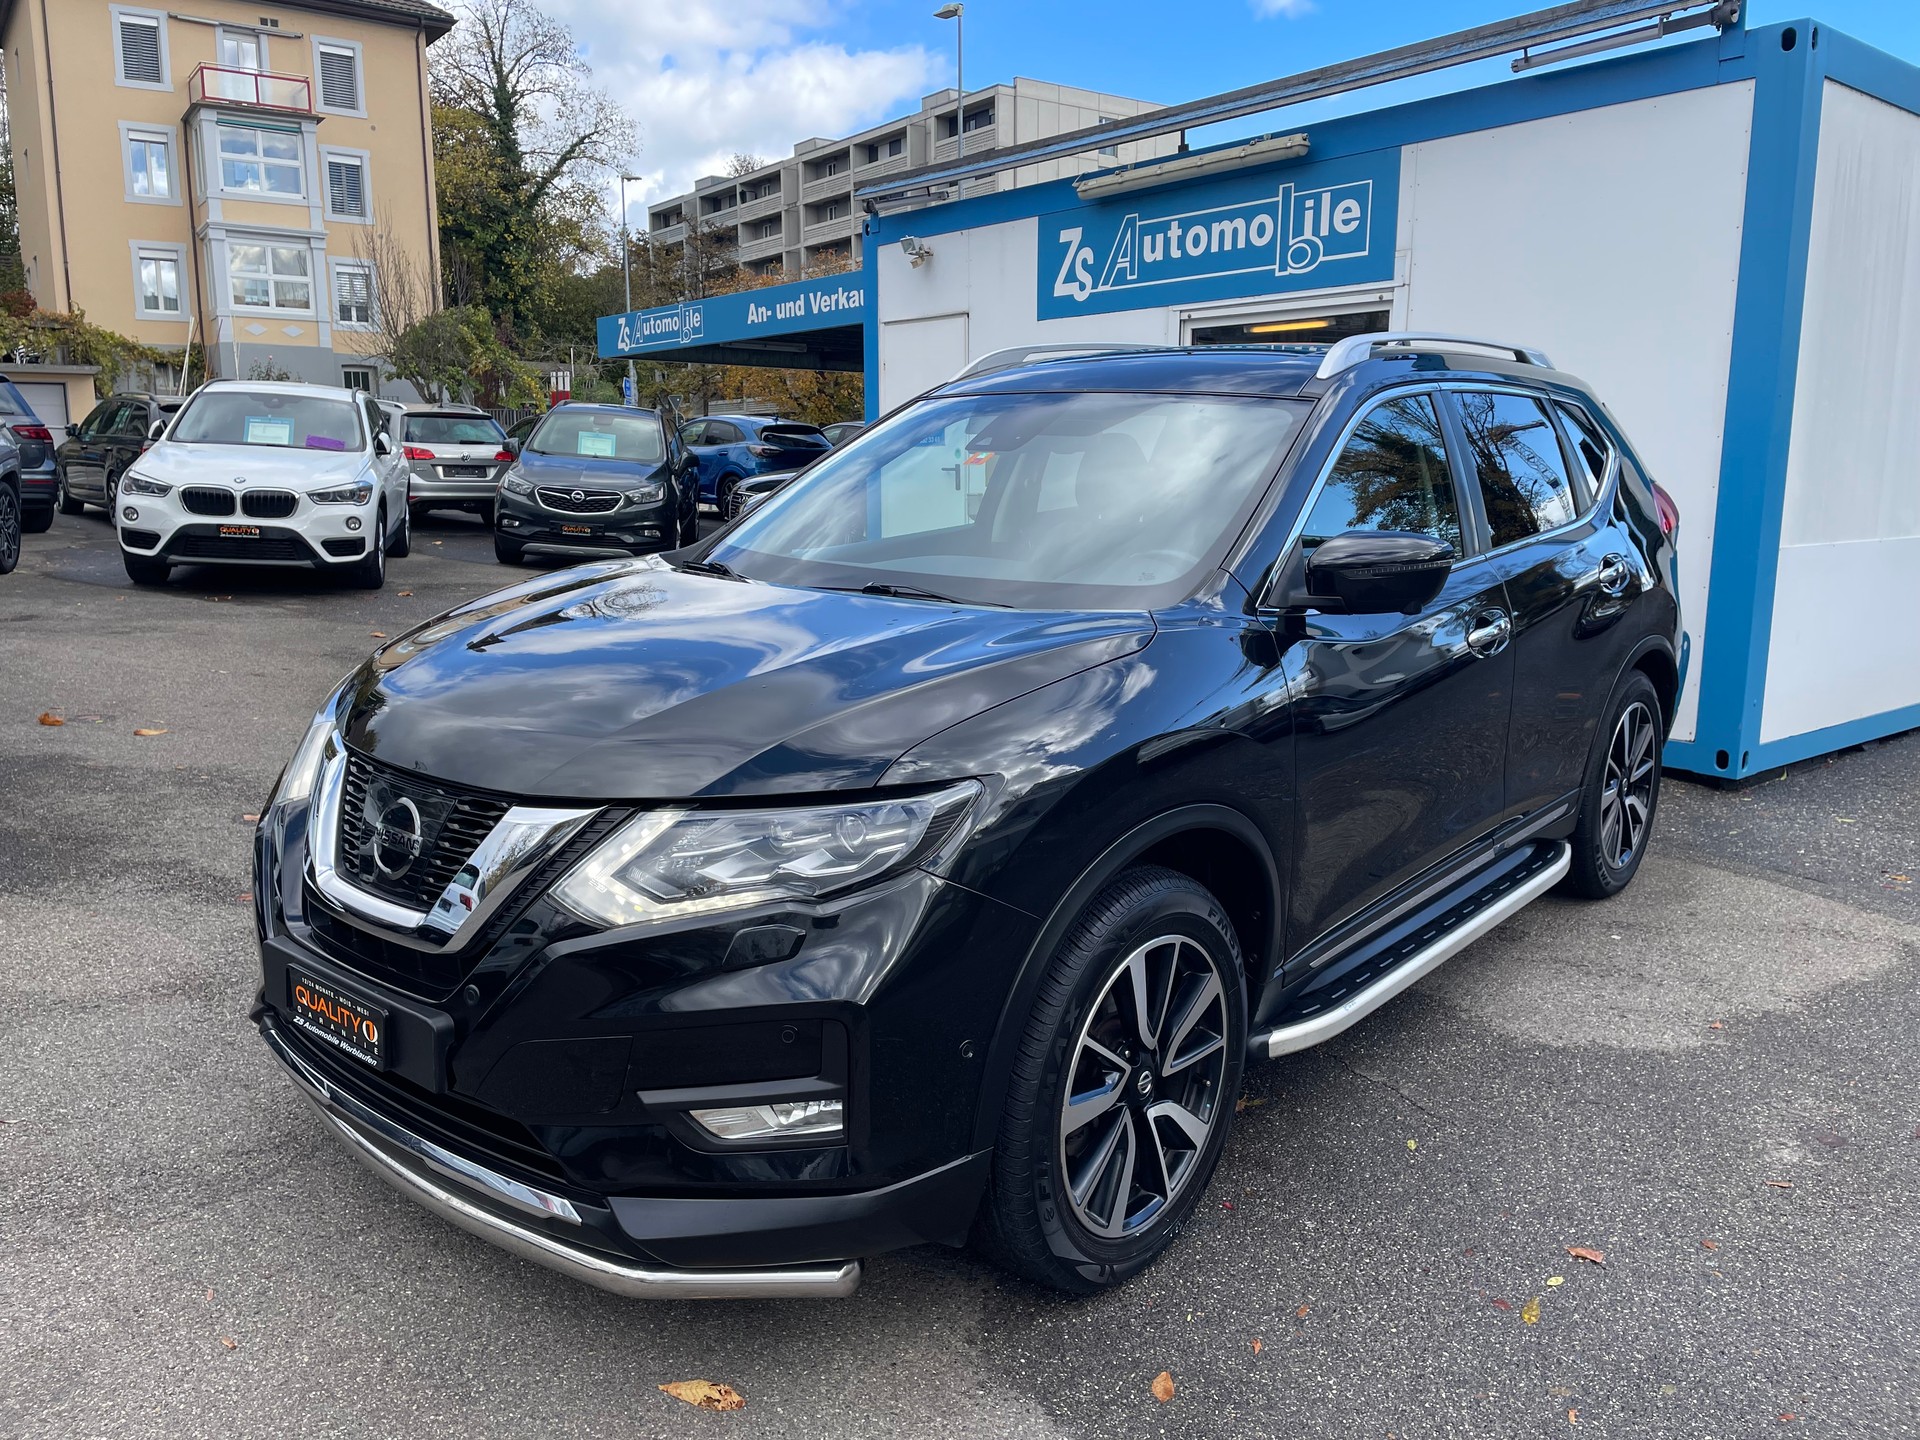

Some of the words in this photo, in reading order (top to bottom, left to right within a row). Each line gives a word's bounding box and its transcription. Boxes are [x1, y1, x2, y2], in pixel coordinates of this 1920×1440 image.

[1099, 182, 1362, 287] Automobile
[631, 304, 701, 347] Automobile
[747, 303, 772, 325] An-
[776, 294, 805, 319] und
[295, 985, 361, 1033] QUALITY
[315, 984, 334, 999] MONATE
[297, 1005, 379, 1055] GARANTIE
[303, 1021, 340, 1046] Automobile
[340, 1040, 378, 1067] Worblaufen
